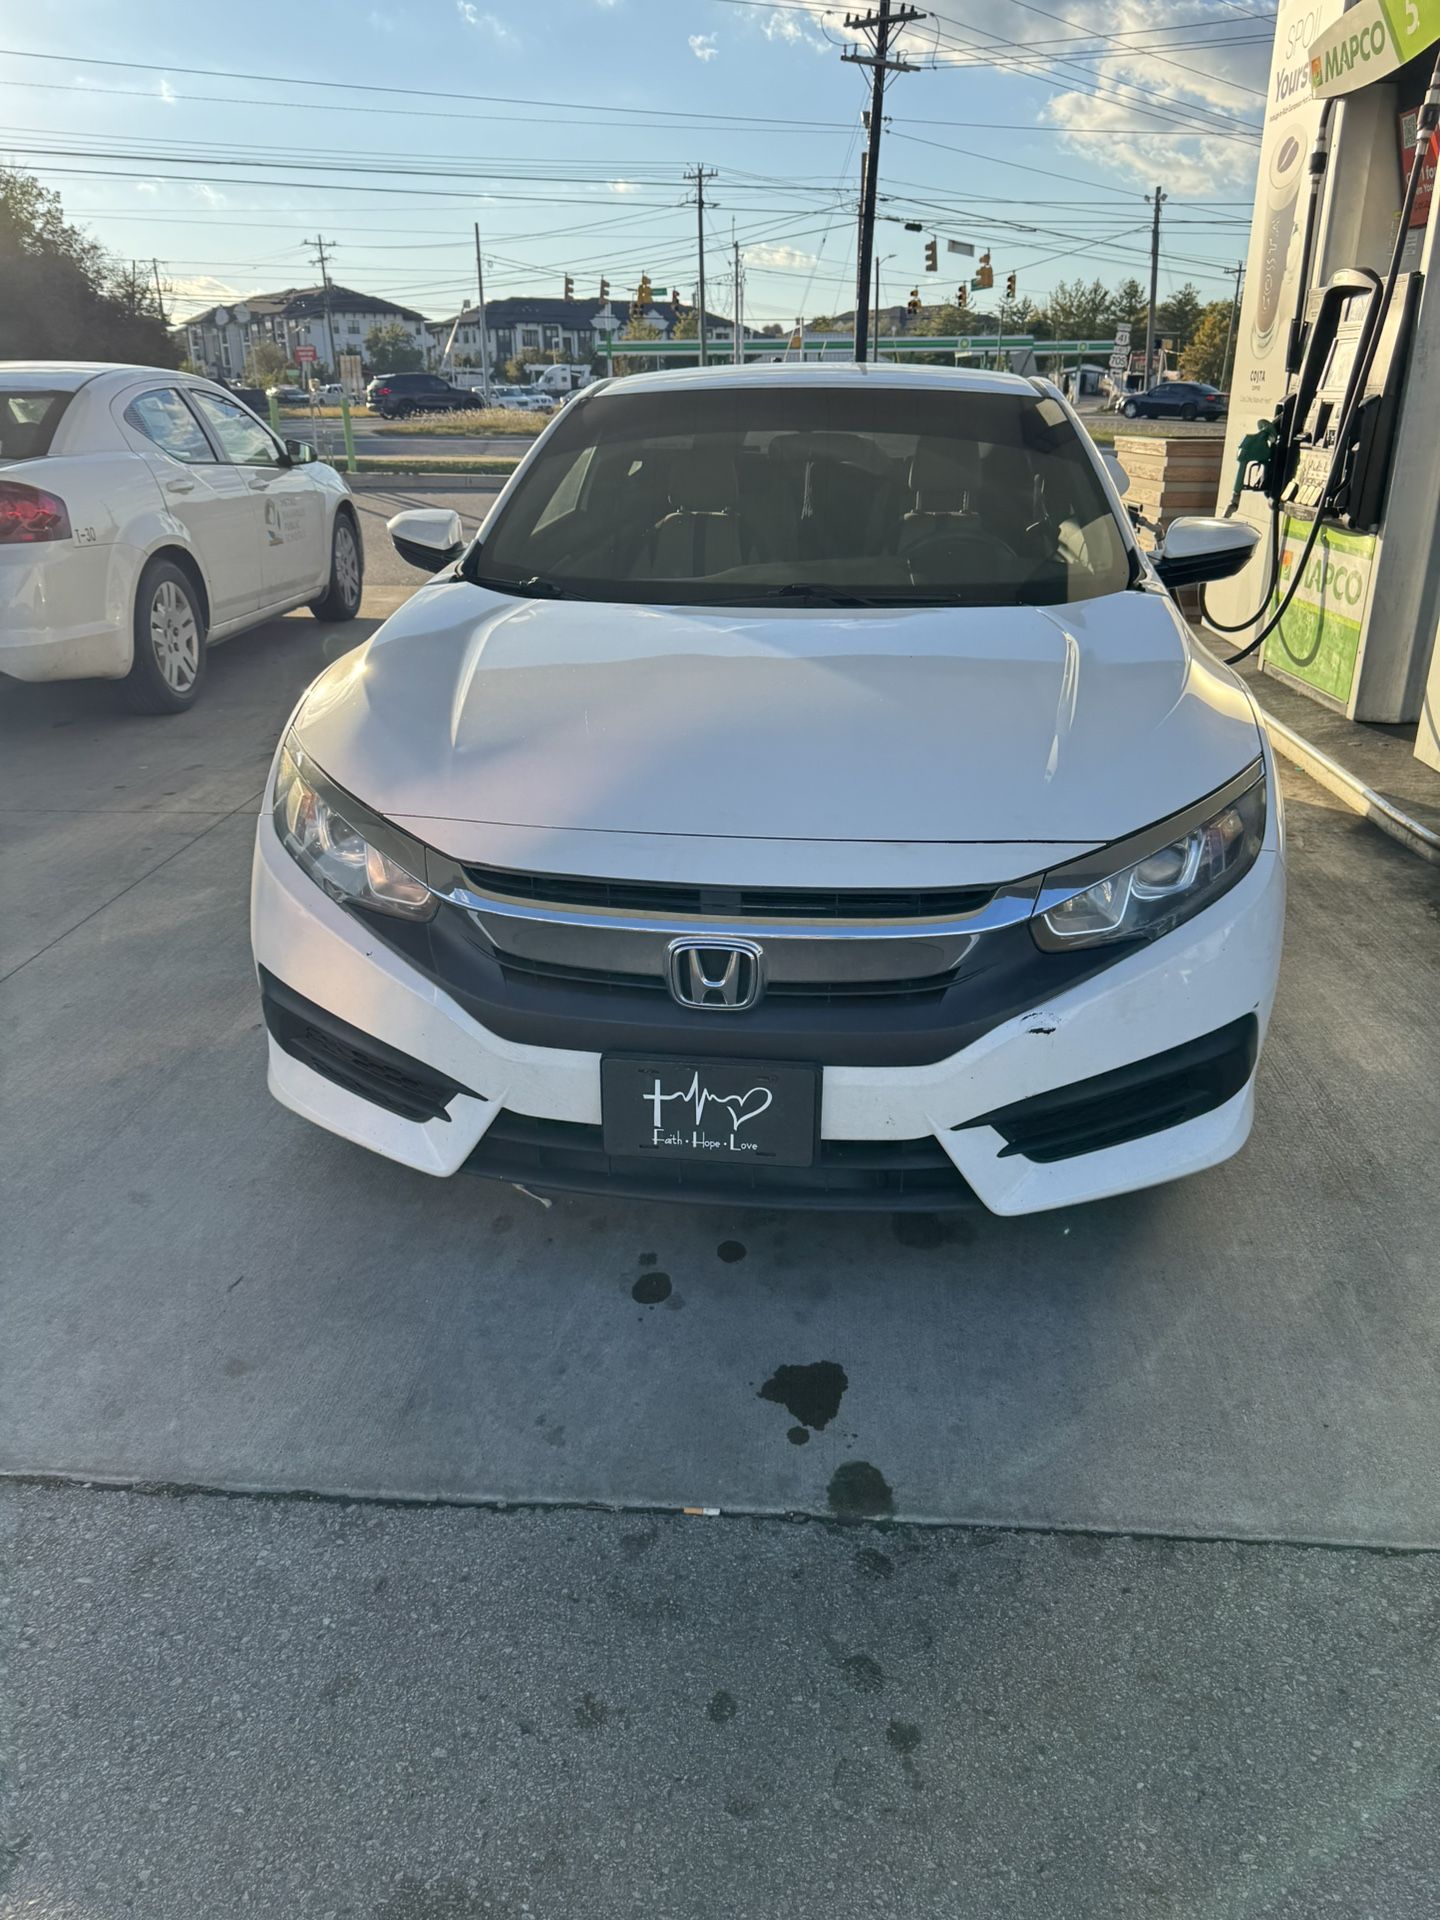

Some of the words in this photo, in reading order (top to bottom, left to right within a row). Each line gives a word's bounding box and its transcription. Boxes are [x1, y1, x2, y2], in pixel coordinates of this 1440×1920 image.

[1325, 20, 1386, 83] MAPCO
[1275, 62, 1312, 103] Yours
[1250, 369, 1266, 383] COSTA
[74, 526, 97, 543] T-30
[652, 1128, 683, 1145] Faith
[691, 1131, 721, 1149] Hope
[730, 1133, 758, 1151] Love
